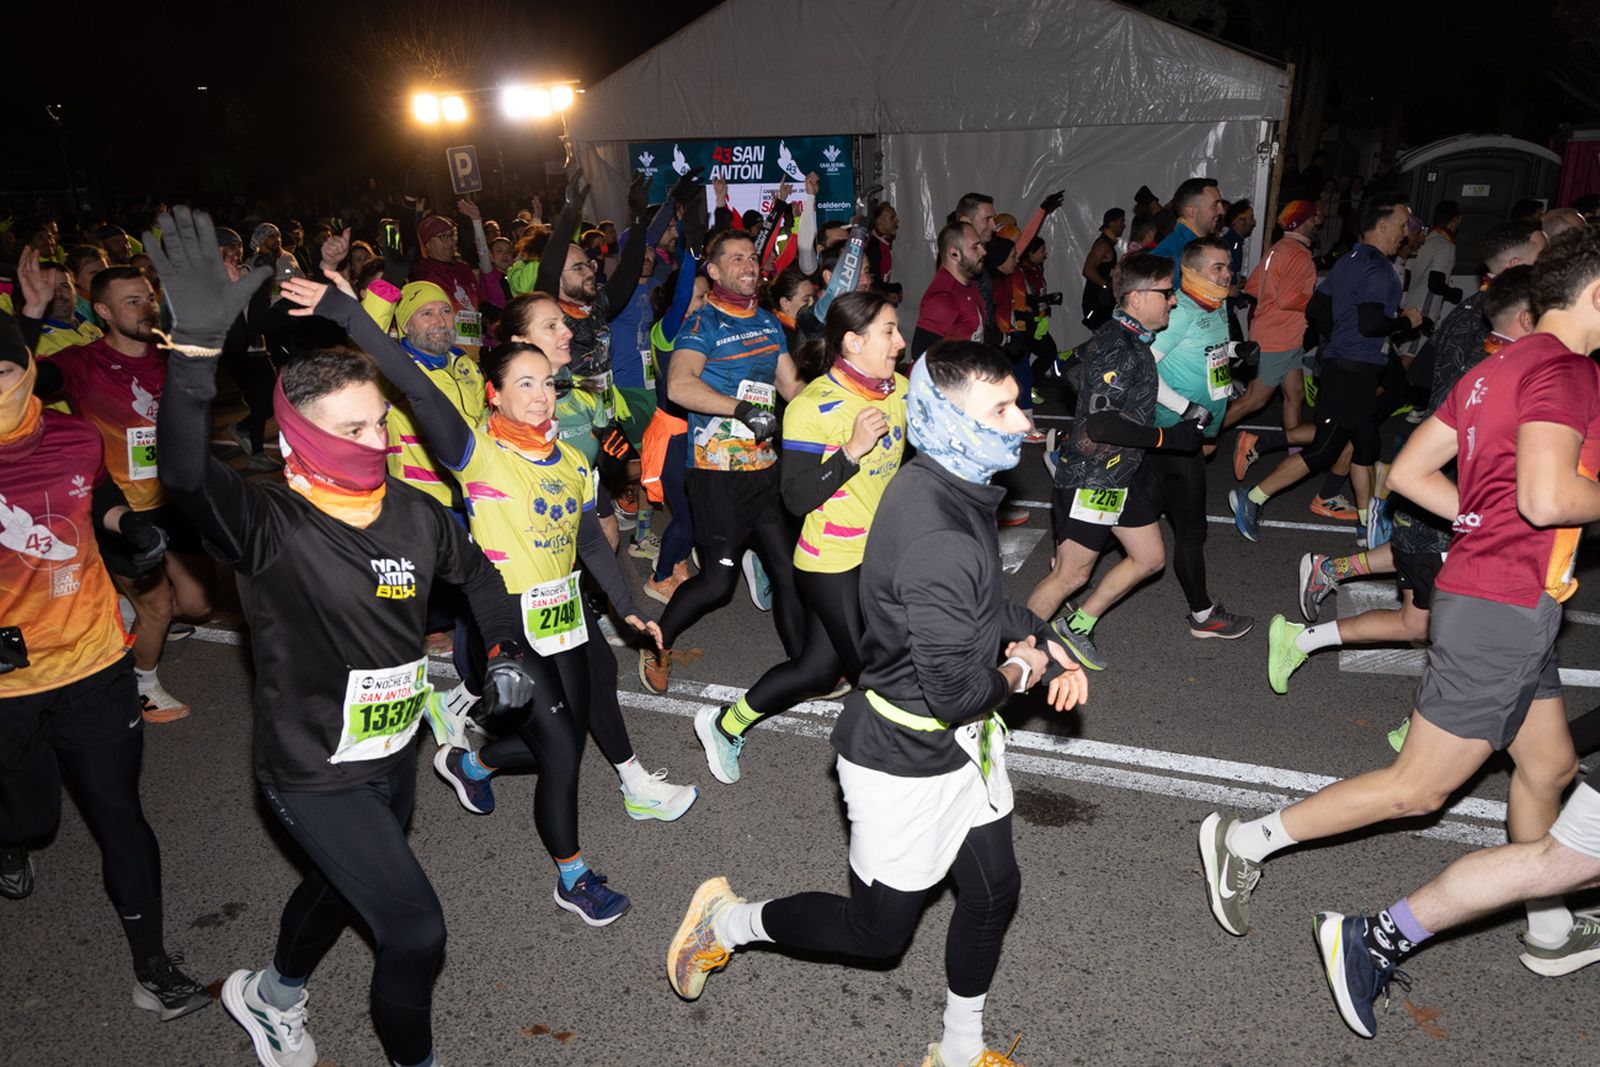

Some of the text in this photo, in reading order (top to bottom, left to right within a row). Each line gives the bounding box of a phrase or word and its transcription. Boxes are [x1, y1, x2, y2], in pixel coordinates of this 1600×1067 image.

[711, 146, 765, 164] 43 SAN
[454, 152, 472, 188] P
[709, 160, 764, 181] ANTÓN
[818, 201, 851, 209] calderón
[716, 334, 740, 347] SIERRA
[26, 533, 52, 555] 43
[376, 584, 416, 599] BOX
[532, 599, 548, 608] SAN
[540, 599, 576, 630] 2748
[358, 693, 382, 703] SAN
